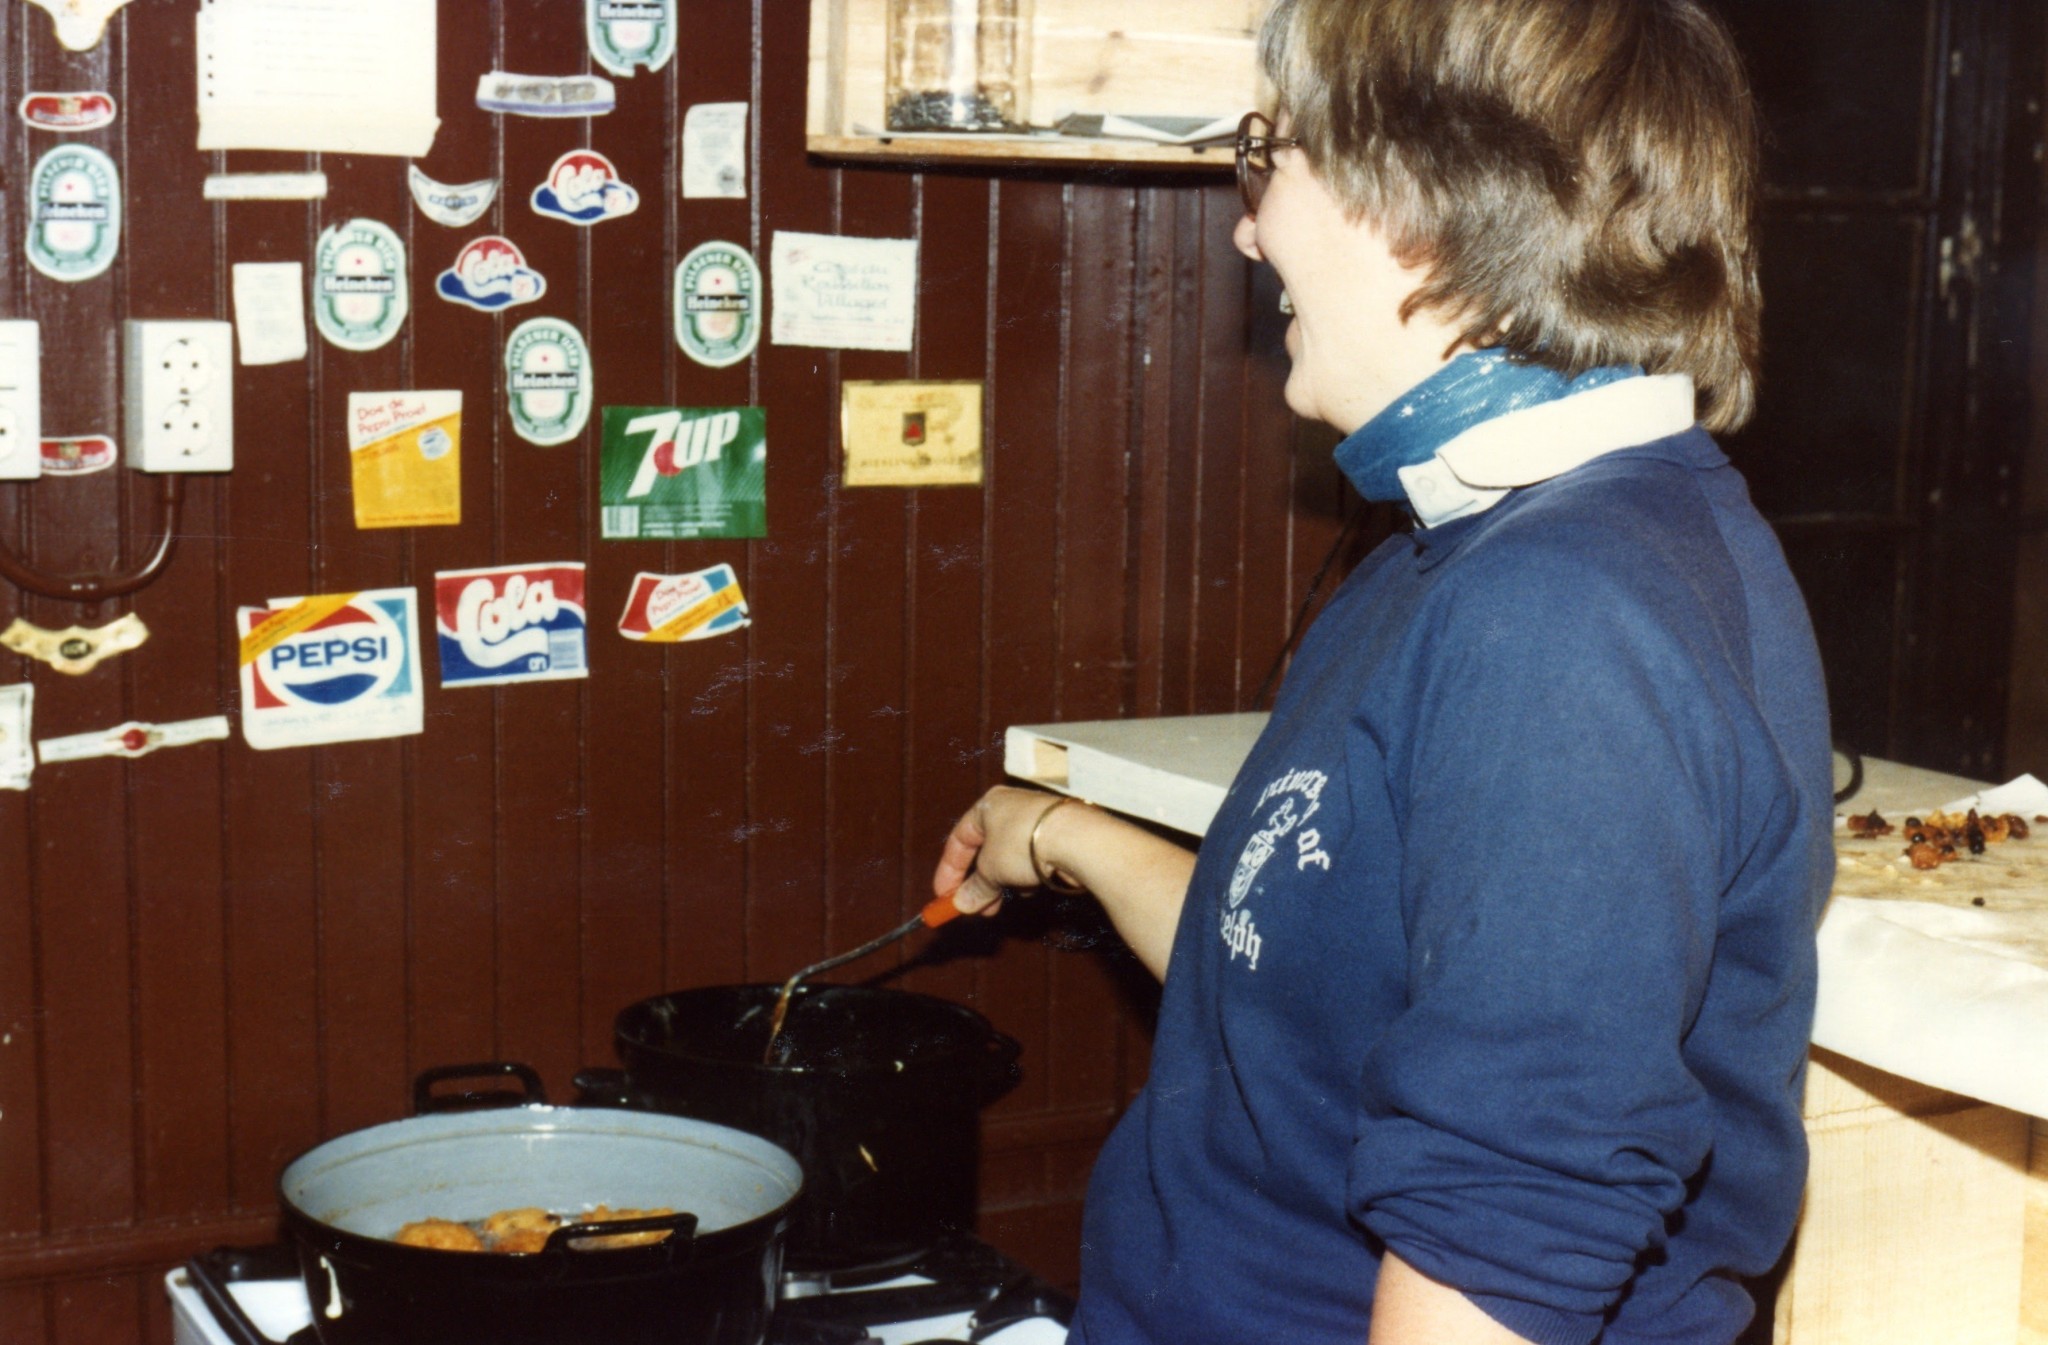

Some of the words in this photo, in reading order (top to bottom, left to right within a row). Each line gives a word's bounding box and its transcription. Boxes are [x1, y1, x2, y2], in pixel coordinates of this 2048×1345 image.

[599, 3, 663, 18] Heineken
[556, 163, 607, 212] Cola
[323, 275, 393, 291] Heineken
[461, 249, 516, 298] Cola
[684, 252, 732, 289] PILSENER
[686, 295, 749, 310] Heineken
[511, 329, 559, 367] PILSENER
[512, 372, 578, 388] Heineken
[357, 404, 384, 420] Doe
[456, 574, 560, 669] Cola
[270, 636, 388, 670] PEPSI
